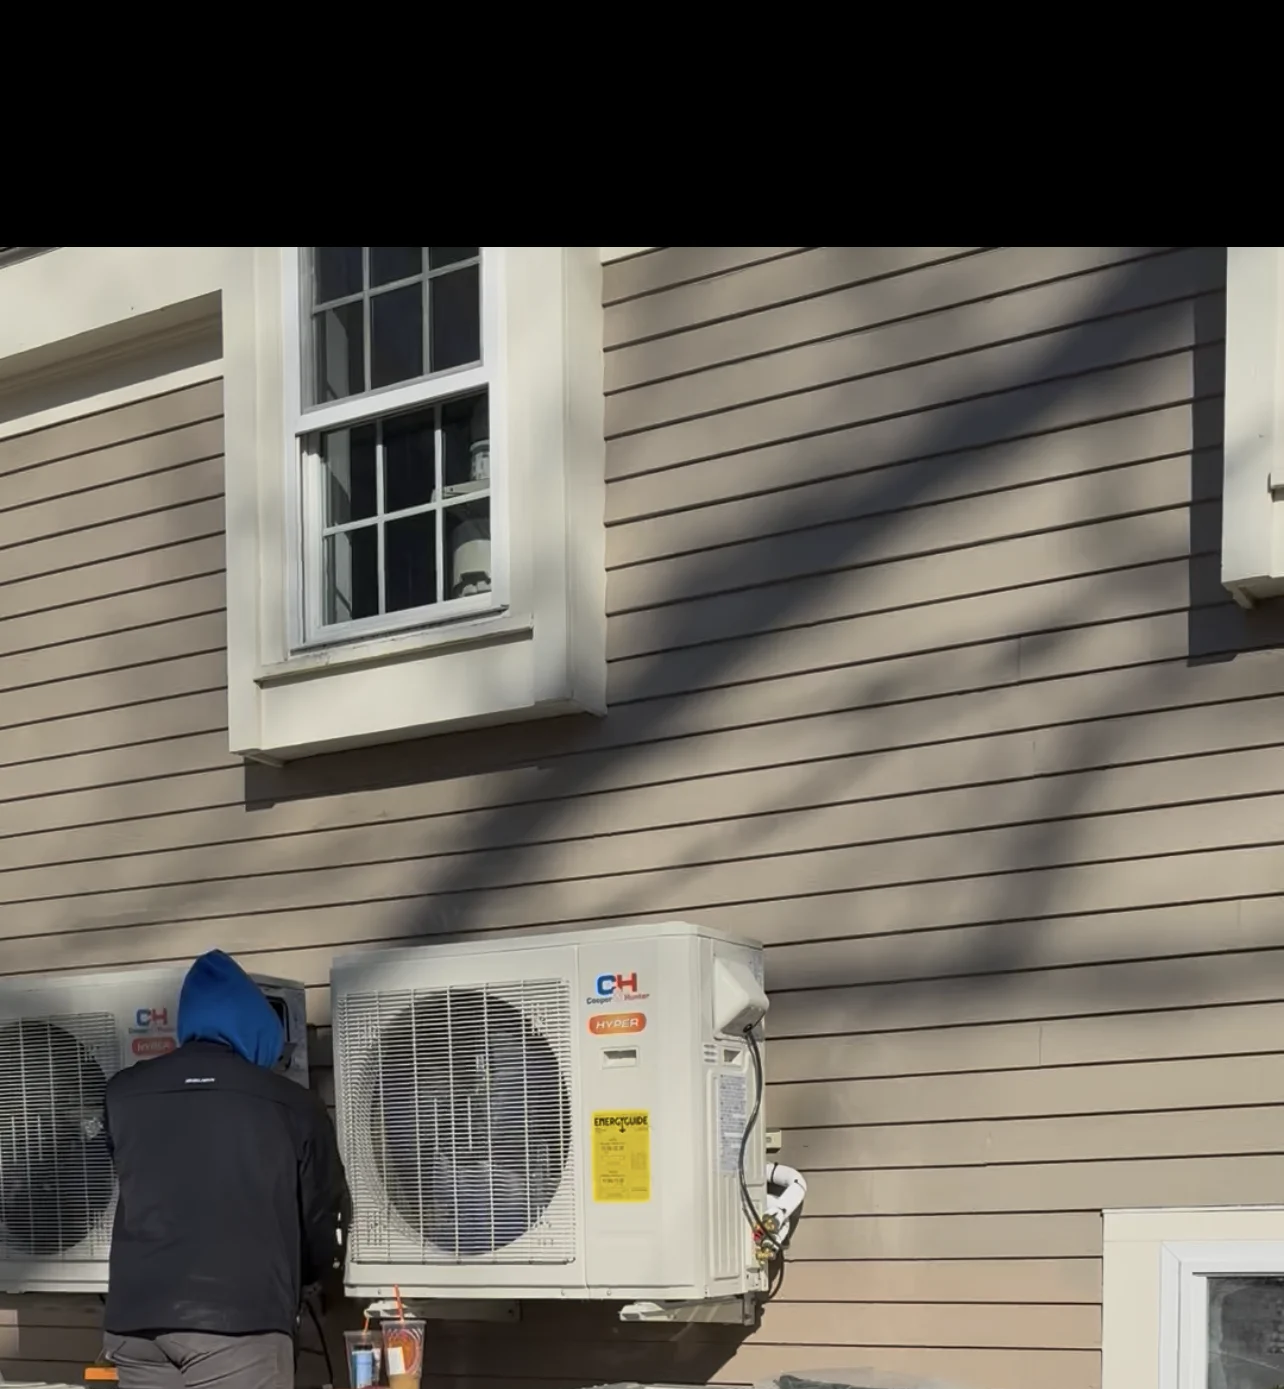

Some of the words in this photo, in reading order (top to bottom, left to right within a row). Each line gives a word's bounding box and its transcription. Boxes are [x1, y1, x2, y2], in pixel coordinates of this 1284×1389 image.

[597, 973, 637, 996] CH
[586, 997, 613, 1006] Cooper
[137, 1008, 168, 1027] CH
[596, 1018, 639, 1030] HYPER
